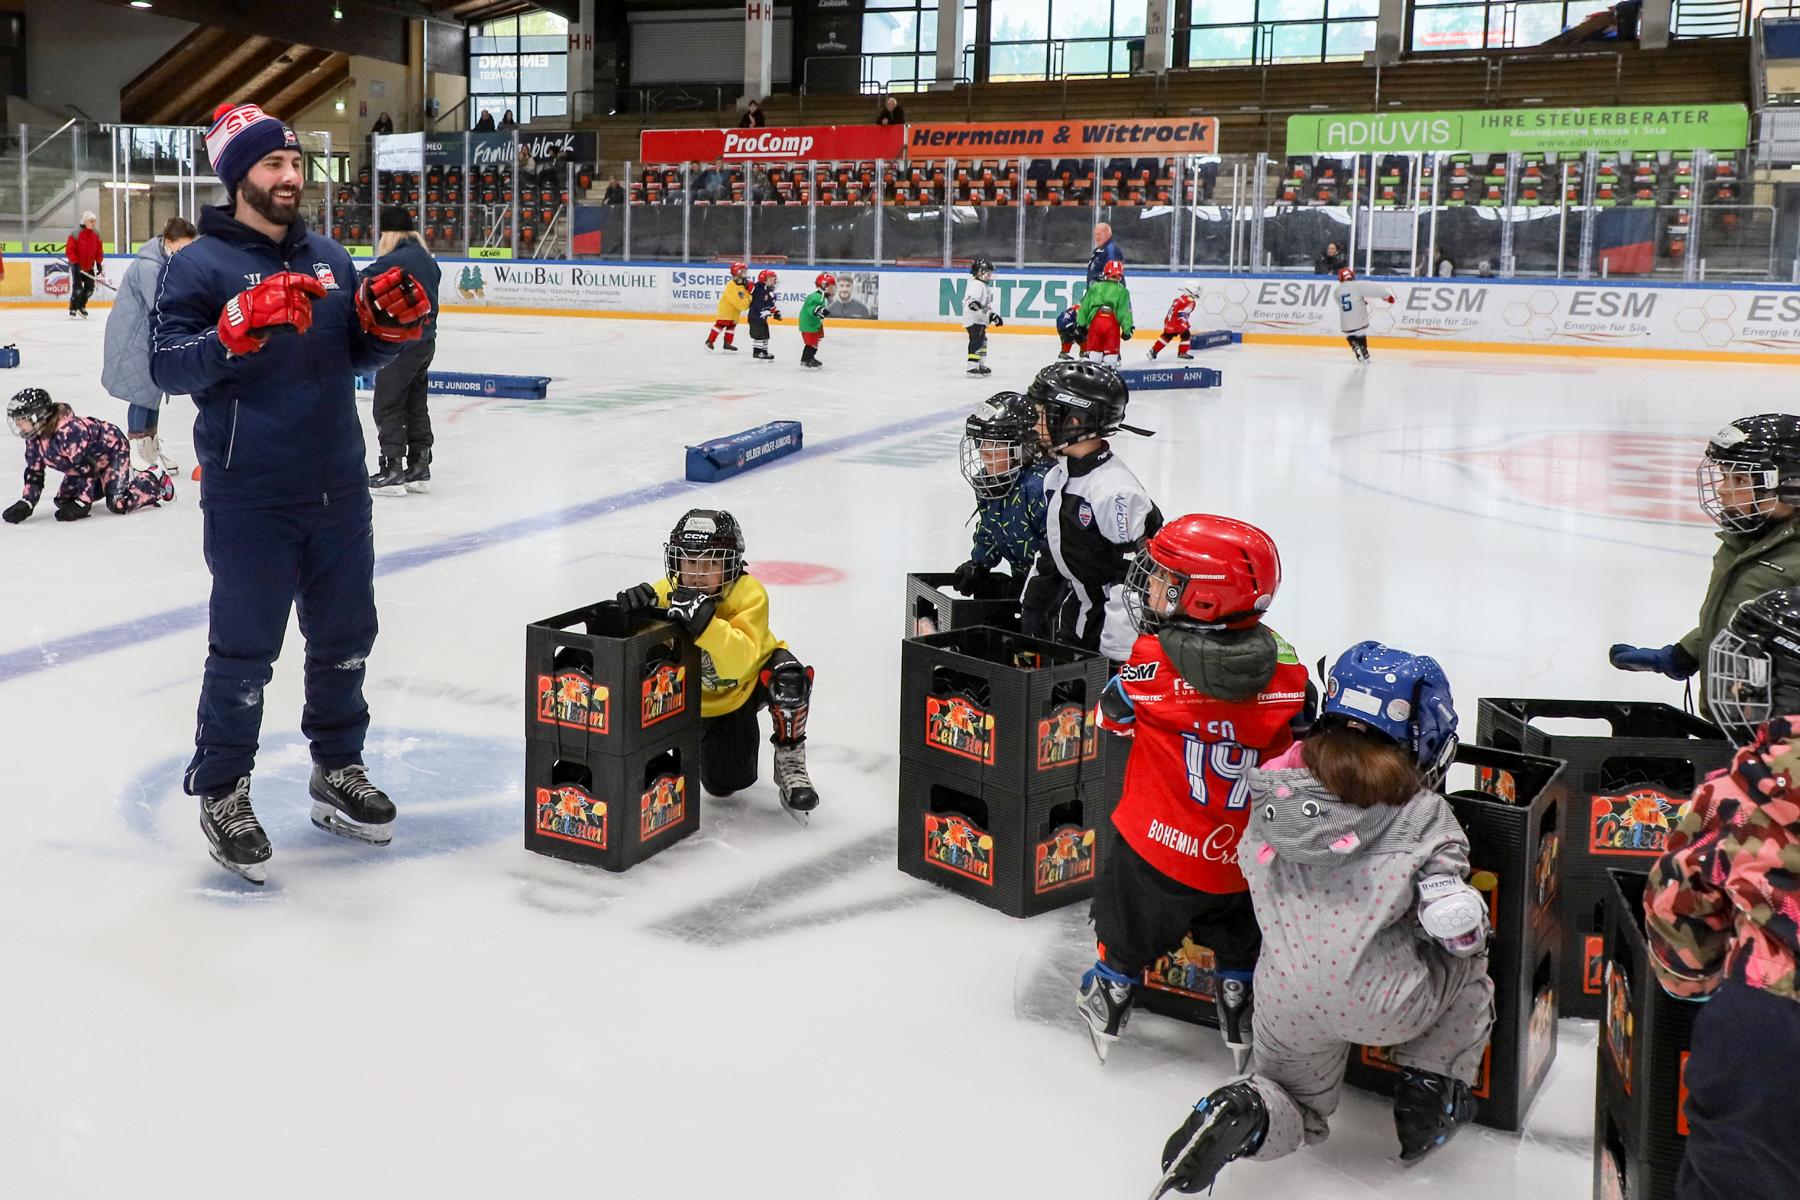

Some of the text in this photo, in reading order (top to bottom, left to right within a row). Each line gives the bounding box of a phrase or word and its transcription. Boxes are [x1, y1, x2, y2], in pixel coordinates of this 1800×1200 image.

[748, 4, 760, 20] H
[765, 4, 771, 21] H
[569, 34, 580, 50] H
[584, 34, 592, 50] H
[226, 110, 262, 134] SE
[1481, 110, 1710, 127] IHRE STEUERBERATER
[912, 120, 1209, 147] Herrmann & Wittrock
[723, 133, 813, 157] ProComp
[672, 290, 711, 300] WERDE
[774, 292, 807, 302] EAMS
[1257, 282, 1331, 308] ESM
[1341, 294, 1352, 312] 5
[1406, 287, 1487, 313] ESM
[1568, 291, 1658, 318] ESM
[1746, 295, 1800, 322] ES
[1253, 309, 1324, 321] Energie für Sie
[1401, 315, 1442, 327] Energie
[1462, 318, 1479, 327] Sie
[1563, 321, 1648, 333] Energie für Sie
[1742, 327, 1789, 338] Energie
[446, 382, 481, 391] JUNIORS
[1120, 662, 1160, 682] ESM
[1257, 691, 1305, 700] Frankenpo
[1179, 731, 1259, 810] 19
[1147, 818, 1199, 858] BOHEMIA
[1596, 819, 1669, 851] Leikei
